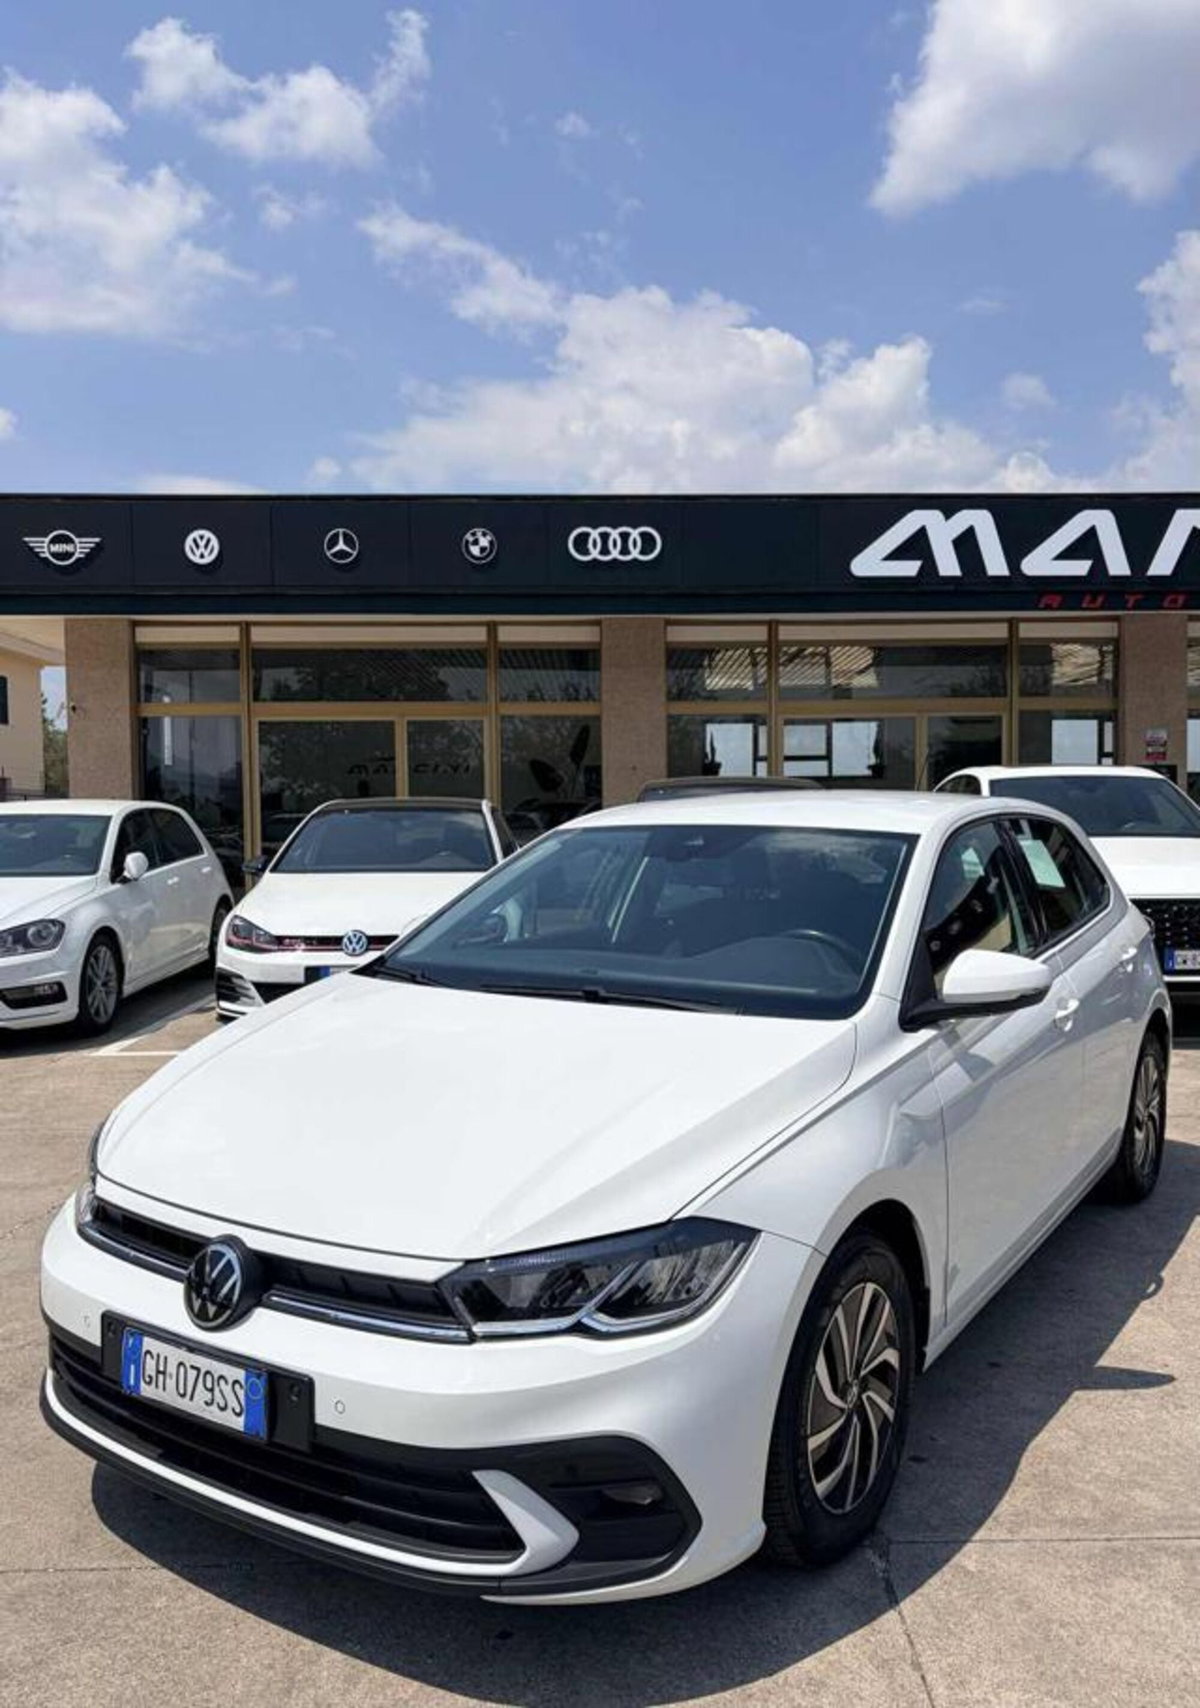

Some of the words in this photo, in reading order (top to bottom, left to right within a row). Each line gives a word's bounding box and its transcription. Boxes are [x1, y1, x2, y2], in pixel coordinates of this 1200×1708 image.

[49, 543, 75, 554] MINI
[1038, 594, 1187, 608] AUTO
[175, 1361, 244, 1417] 079SS
